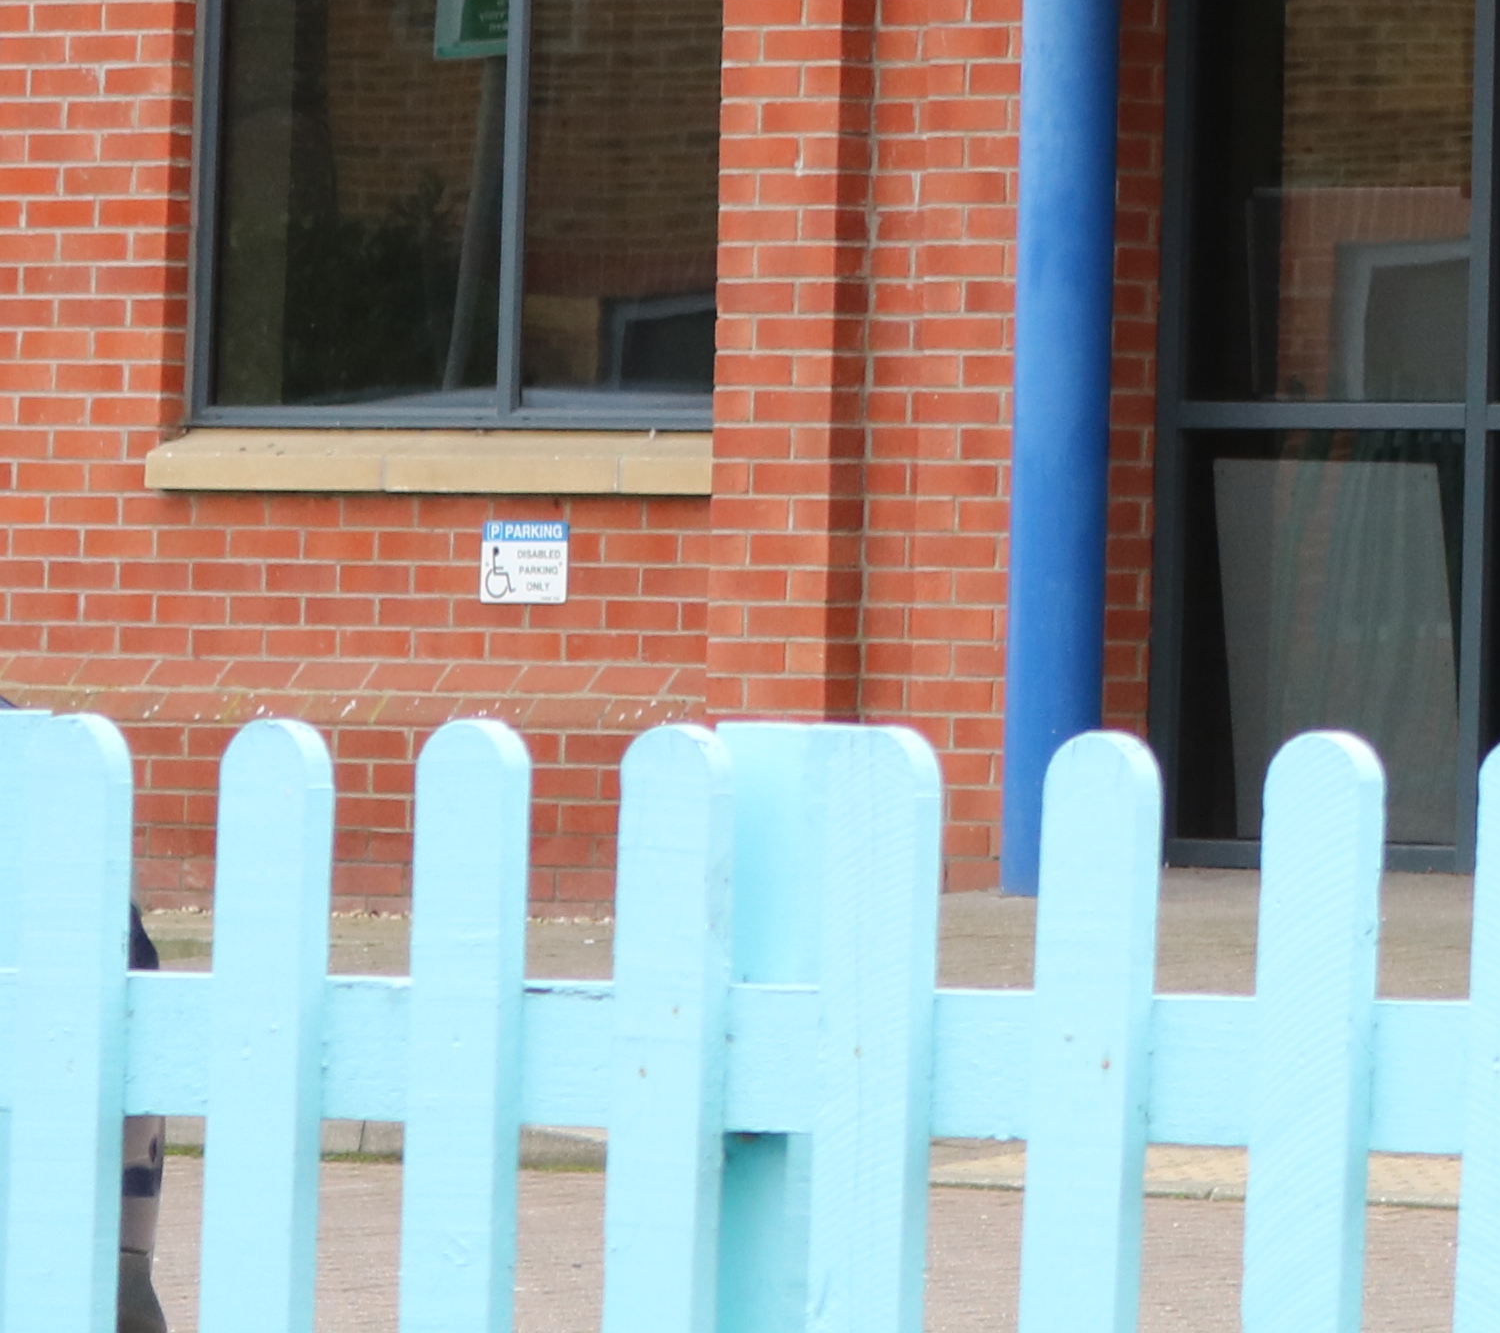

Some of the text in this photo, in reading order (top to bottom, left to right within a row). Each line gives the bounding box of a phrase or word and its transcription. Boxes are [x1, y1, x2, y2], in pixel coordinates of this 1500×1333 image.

[504, 523, 563, 539] PARKING
[517, 549, 561, 559] DISABLED
[518, 565, 559, 576] PARKING
[526, 581, 550, 592] ONLY
